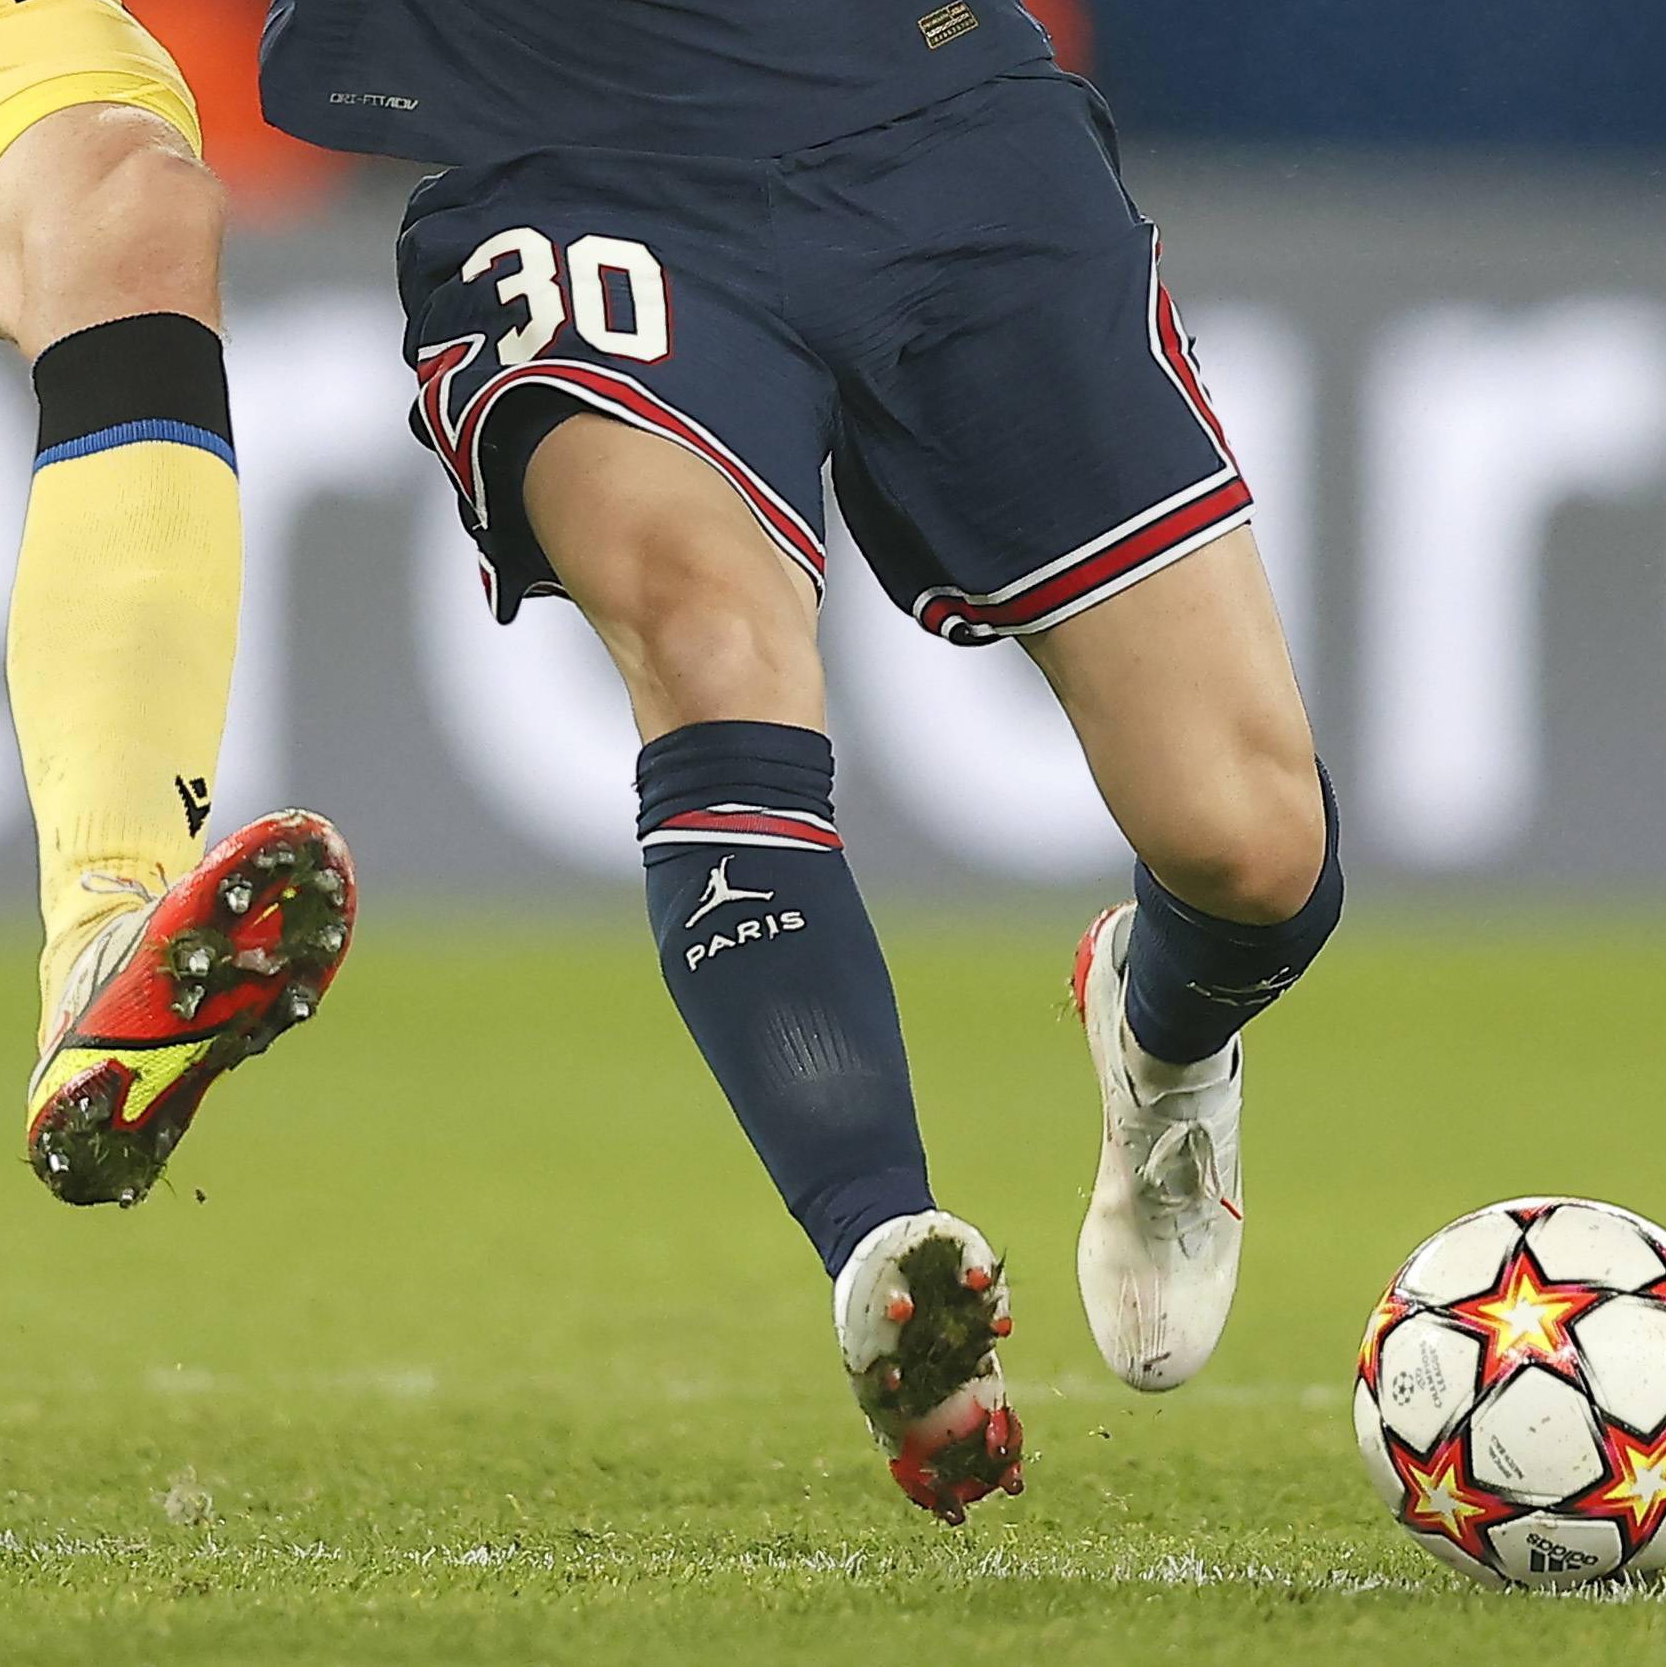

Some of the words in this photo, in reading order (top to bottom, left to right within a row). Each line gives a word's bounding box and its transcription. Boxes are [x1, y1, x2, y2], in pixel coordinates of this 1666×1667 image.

[461, 226, 674, 366] 30
[685, 910, 806, 972] PARIS
[1525, 1532, 1600, 1567] adidas
